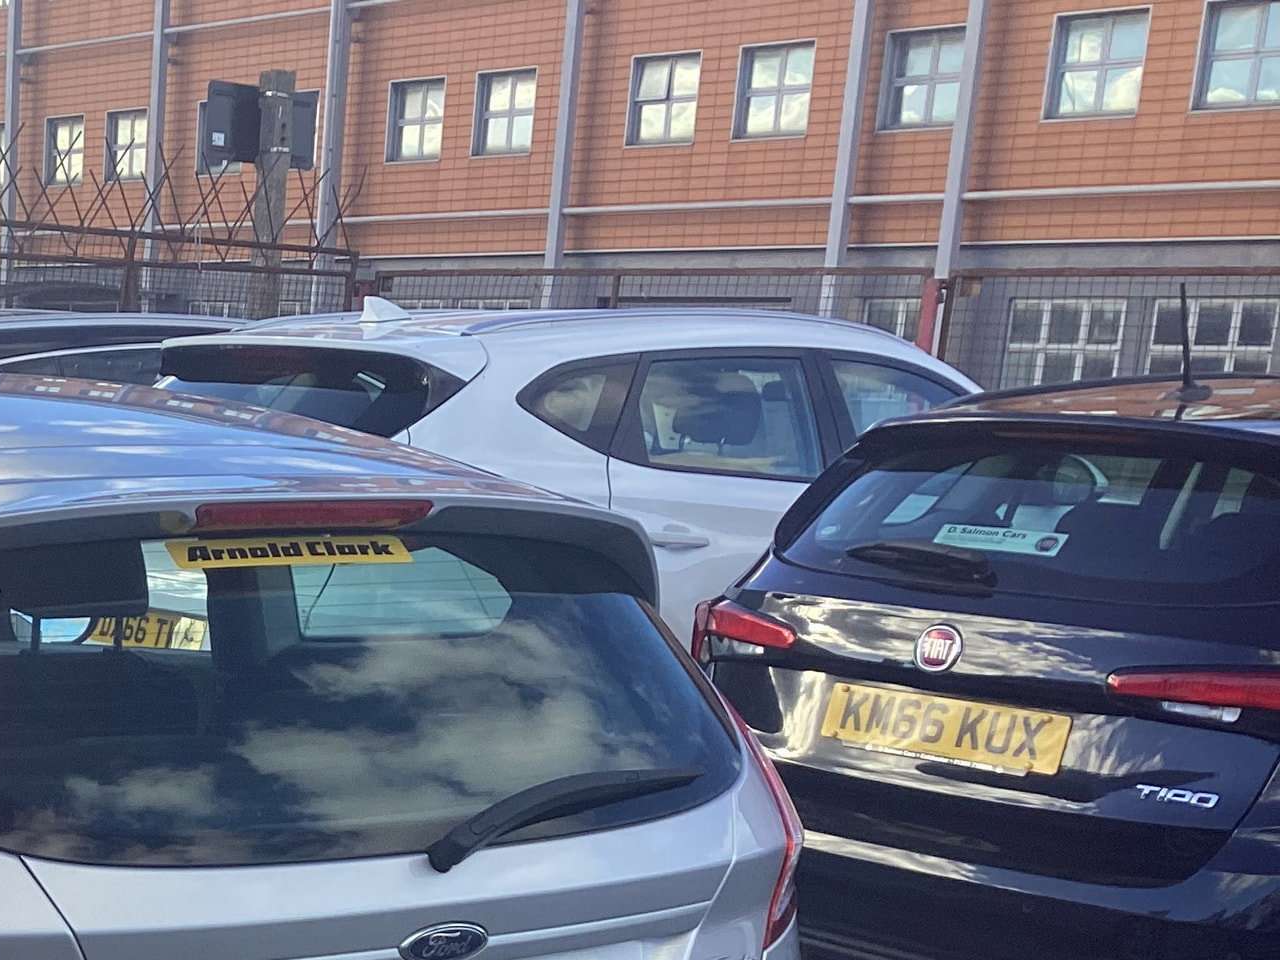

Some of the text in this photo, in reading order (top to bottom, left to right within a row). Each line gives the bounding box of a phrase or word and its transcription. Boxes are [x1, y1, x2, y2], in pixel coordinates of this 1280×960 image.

[960, 526, 1000, 538] Salmon
[1002, 530, 1028, 540] Cars
[187, 540, 393, 562] Arnold Clark
[922, 636, 954, 660] FIAT
[840, 690, 950, 744] KM66
[955, 707, 1047, 761] KUX
[1136, 784, 1219, 808] TIPO
[422, 930, 473, 957] Ford
